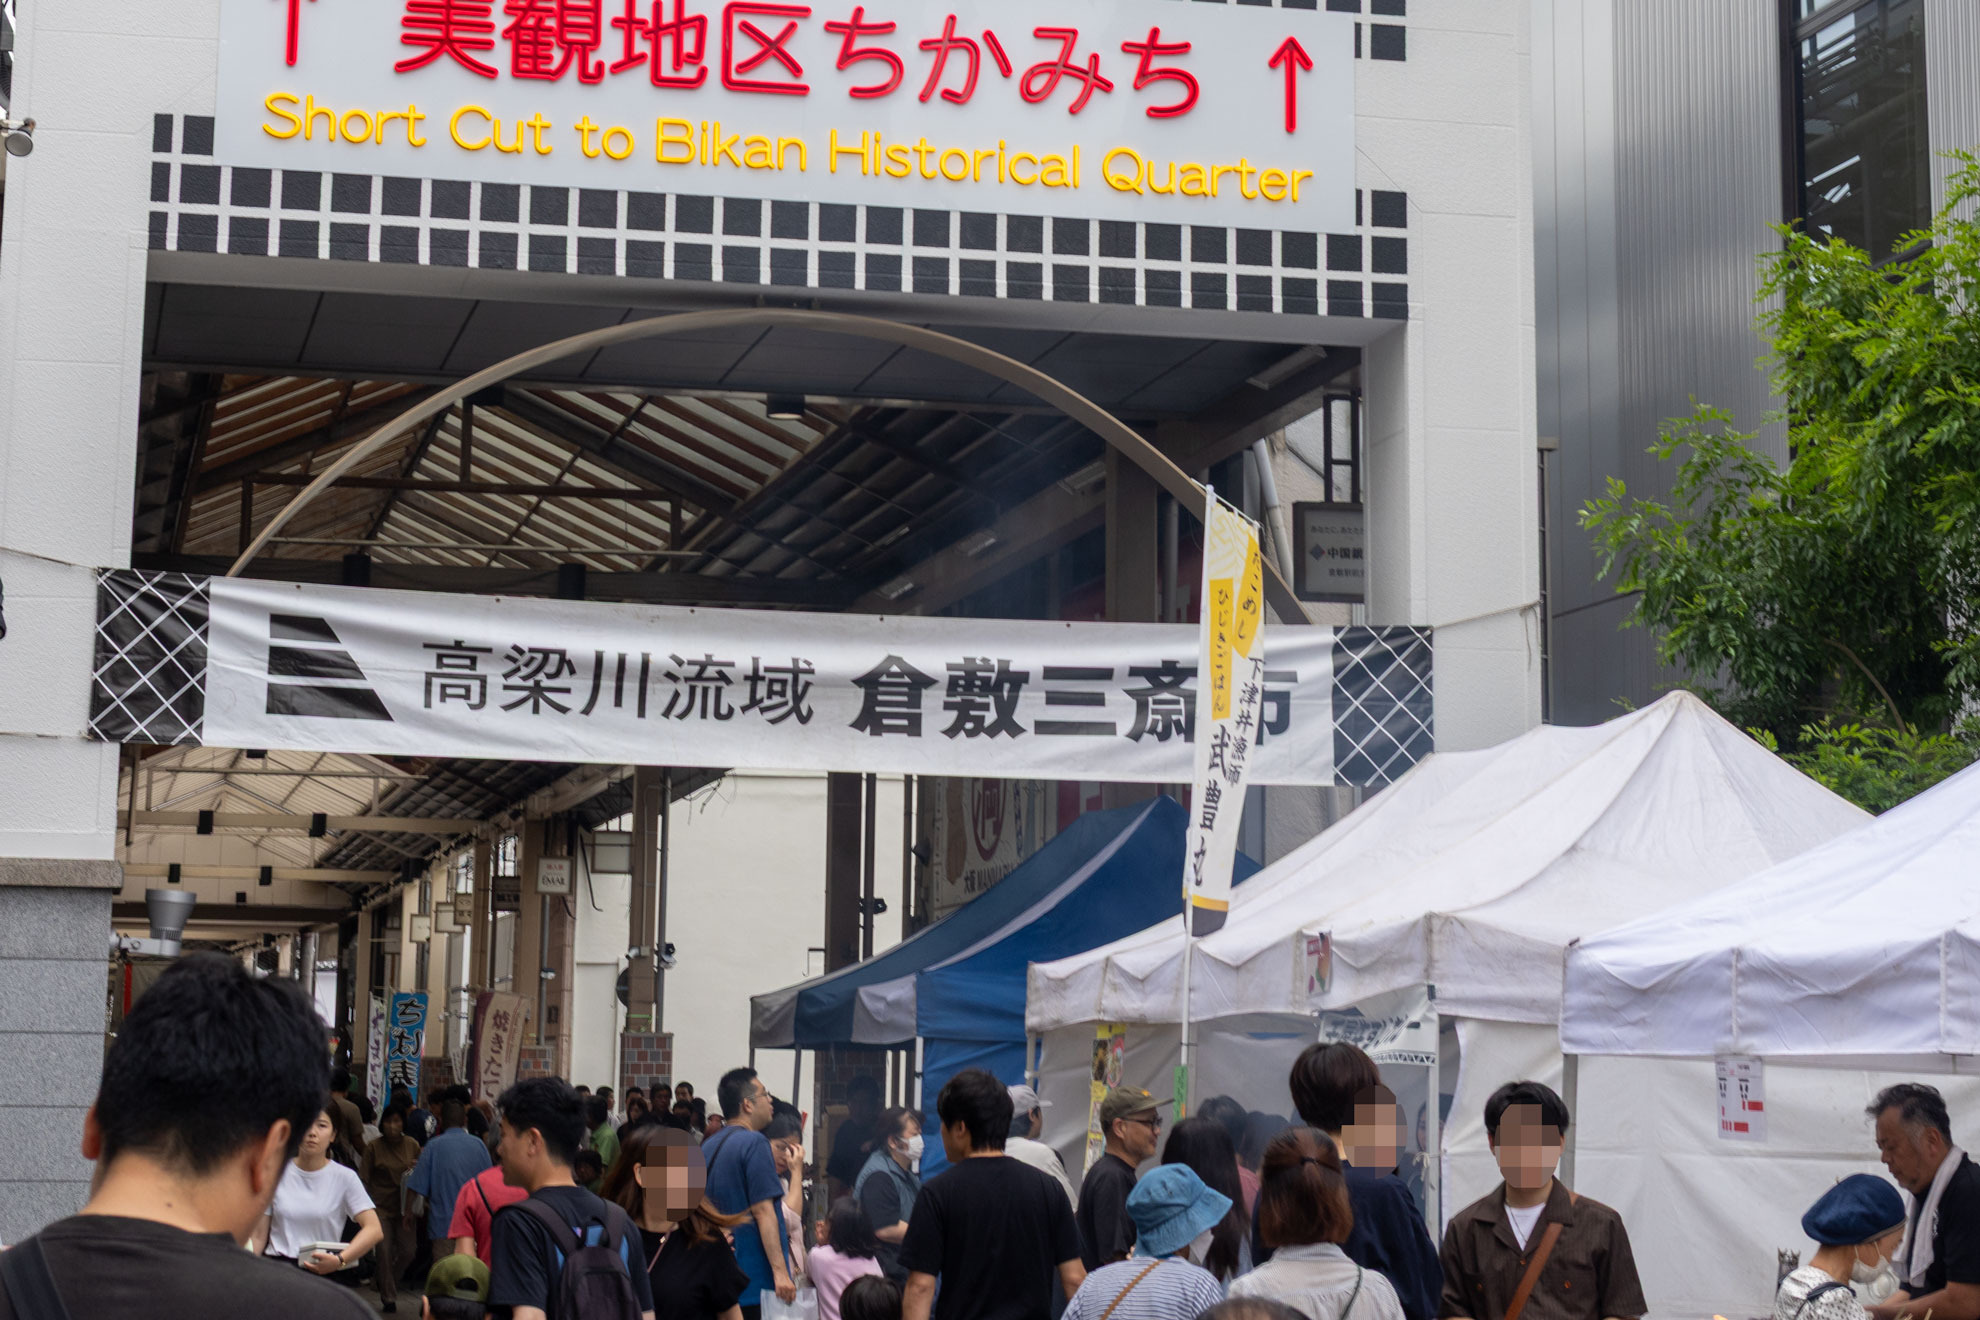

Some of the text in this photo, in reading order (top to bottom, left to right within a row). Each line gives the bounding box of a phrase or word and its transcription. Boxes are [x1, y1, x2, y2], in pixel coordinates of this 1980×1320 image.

[394, 0, 1199, 118] 美観地区ちかみち
[262, 93, 1313, 203] Short Cut to Bikan Historical Quarter
[423, 640, 816, 725] 高梁川流域
